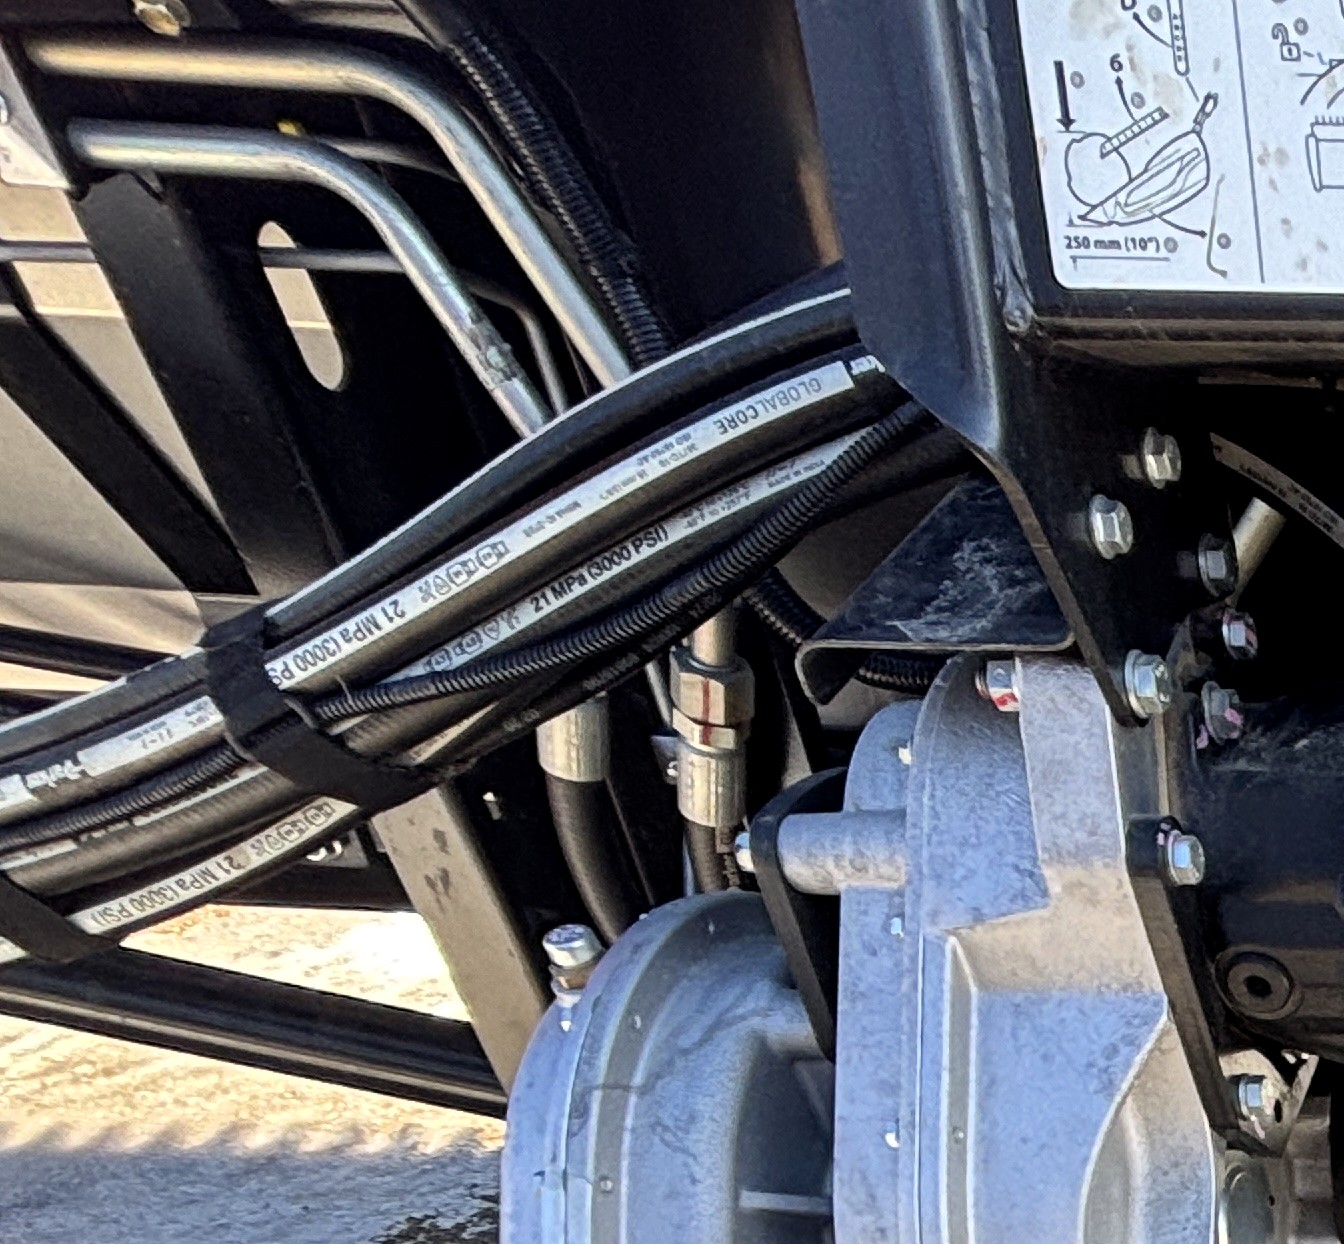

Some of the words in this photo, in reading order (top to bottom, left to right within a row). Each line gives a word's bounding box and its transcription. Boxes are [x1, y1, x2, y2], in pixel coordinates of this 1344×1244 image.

[1109, 53, 1124, 73] 6
[1064, 236, 1091, 250] 250
[1094, 240, 1122, 250] mm
[712, 377, 823, 436] GLOBALCORE
[528, 590, 552, 614] 21
[553, 571, 589, 600] MPa
[585, 545, 633, 583] (3000
[631, 525, 669, 558] PSI)
[385, 599, 408, 624] 21
[340, 614, 383, 645] MPa
[297, 639, 342, 673] (3000
[174, 865, 220, 892] MPa
[130, 881, 180, 914] (3000
[90, 906, 135, 927] PSI)
